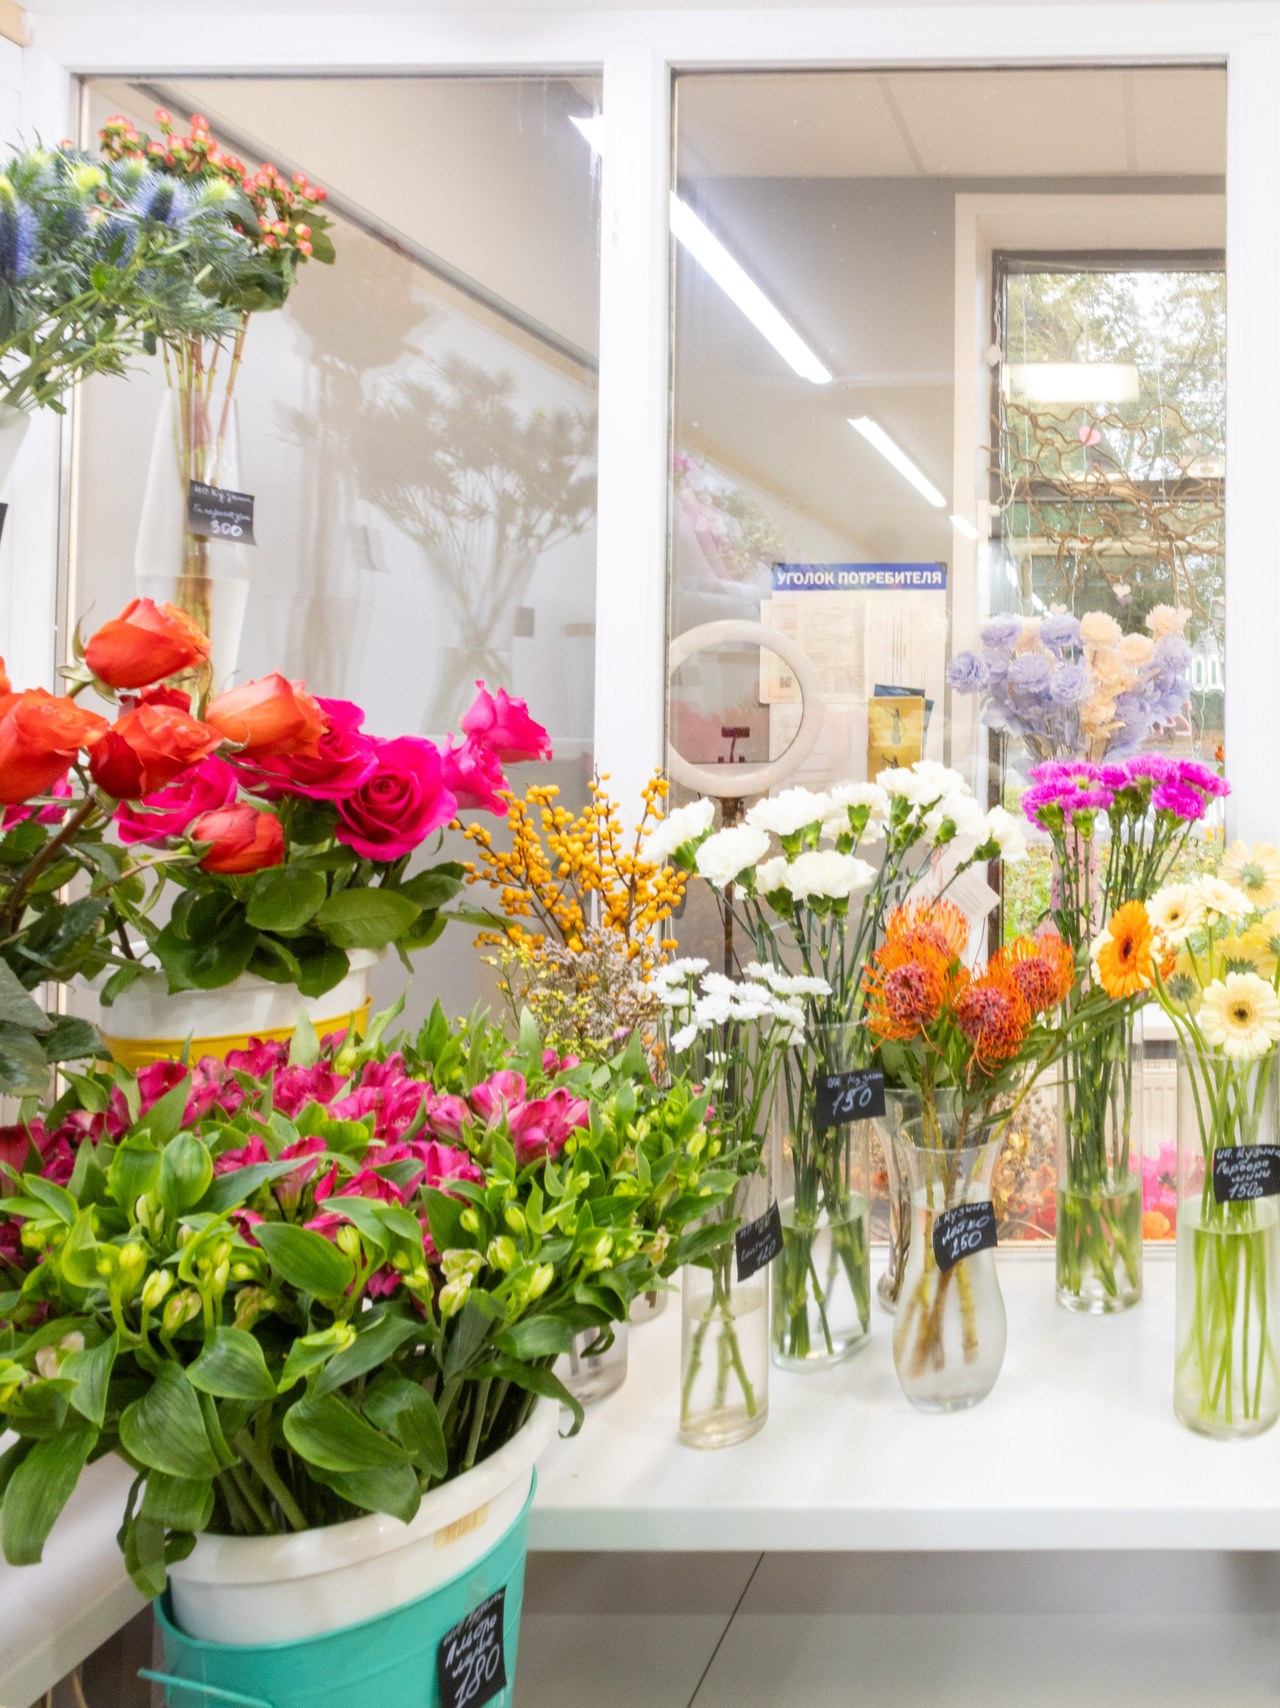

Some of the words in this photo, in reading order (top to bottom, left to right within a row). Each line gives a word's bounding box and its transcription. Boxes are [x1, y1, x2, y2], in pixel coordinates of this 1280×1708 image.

[777, 571, 834, 586] УГОЛОК
[838, 570, 942, 585] ПОТРЕБИТЕЛЯ
[832, 1086, 872, 1116] 150
